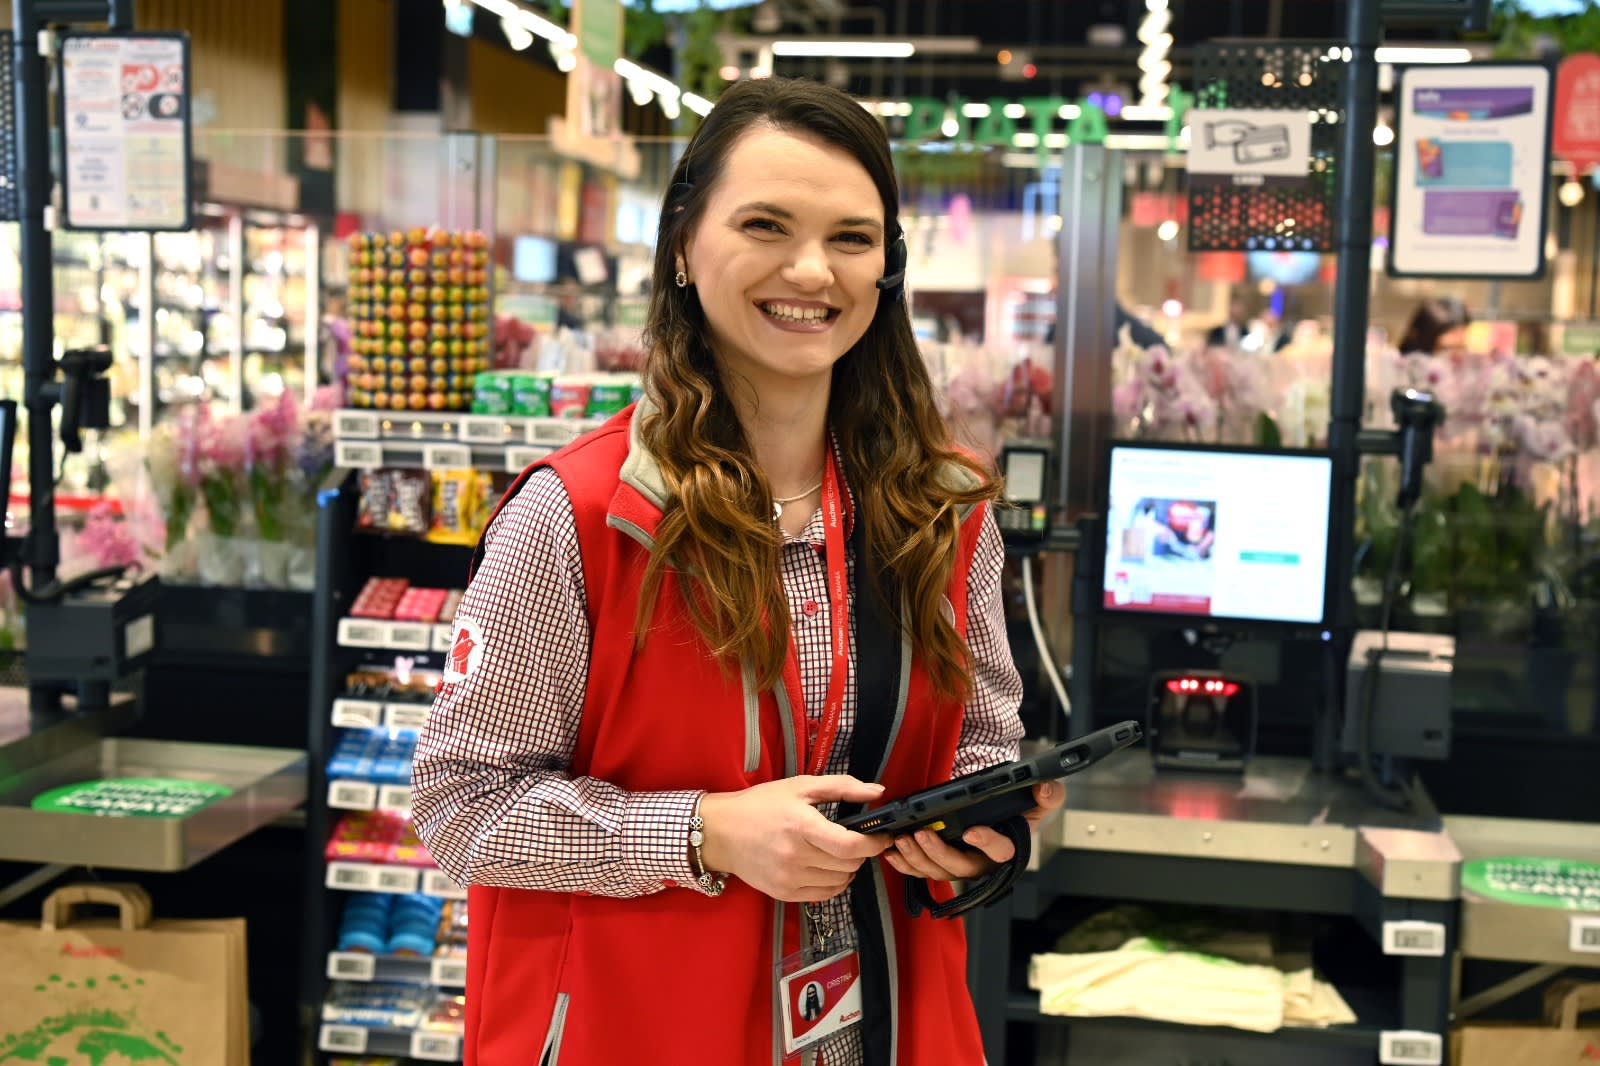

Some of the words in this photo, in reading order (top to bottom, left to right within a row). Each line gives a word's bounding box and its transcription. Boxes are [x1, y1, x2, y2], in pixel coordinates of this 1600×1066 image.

[829, 501, 838, 527] Auchan
[826, 702, 837, 732] ROMANIA
[826, 972, 853, 989] CRISTINA
[839, 1010, 861, 1023] Auchan
